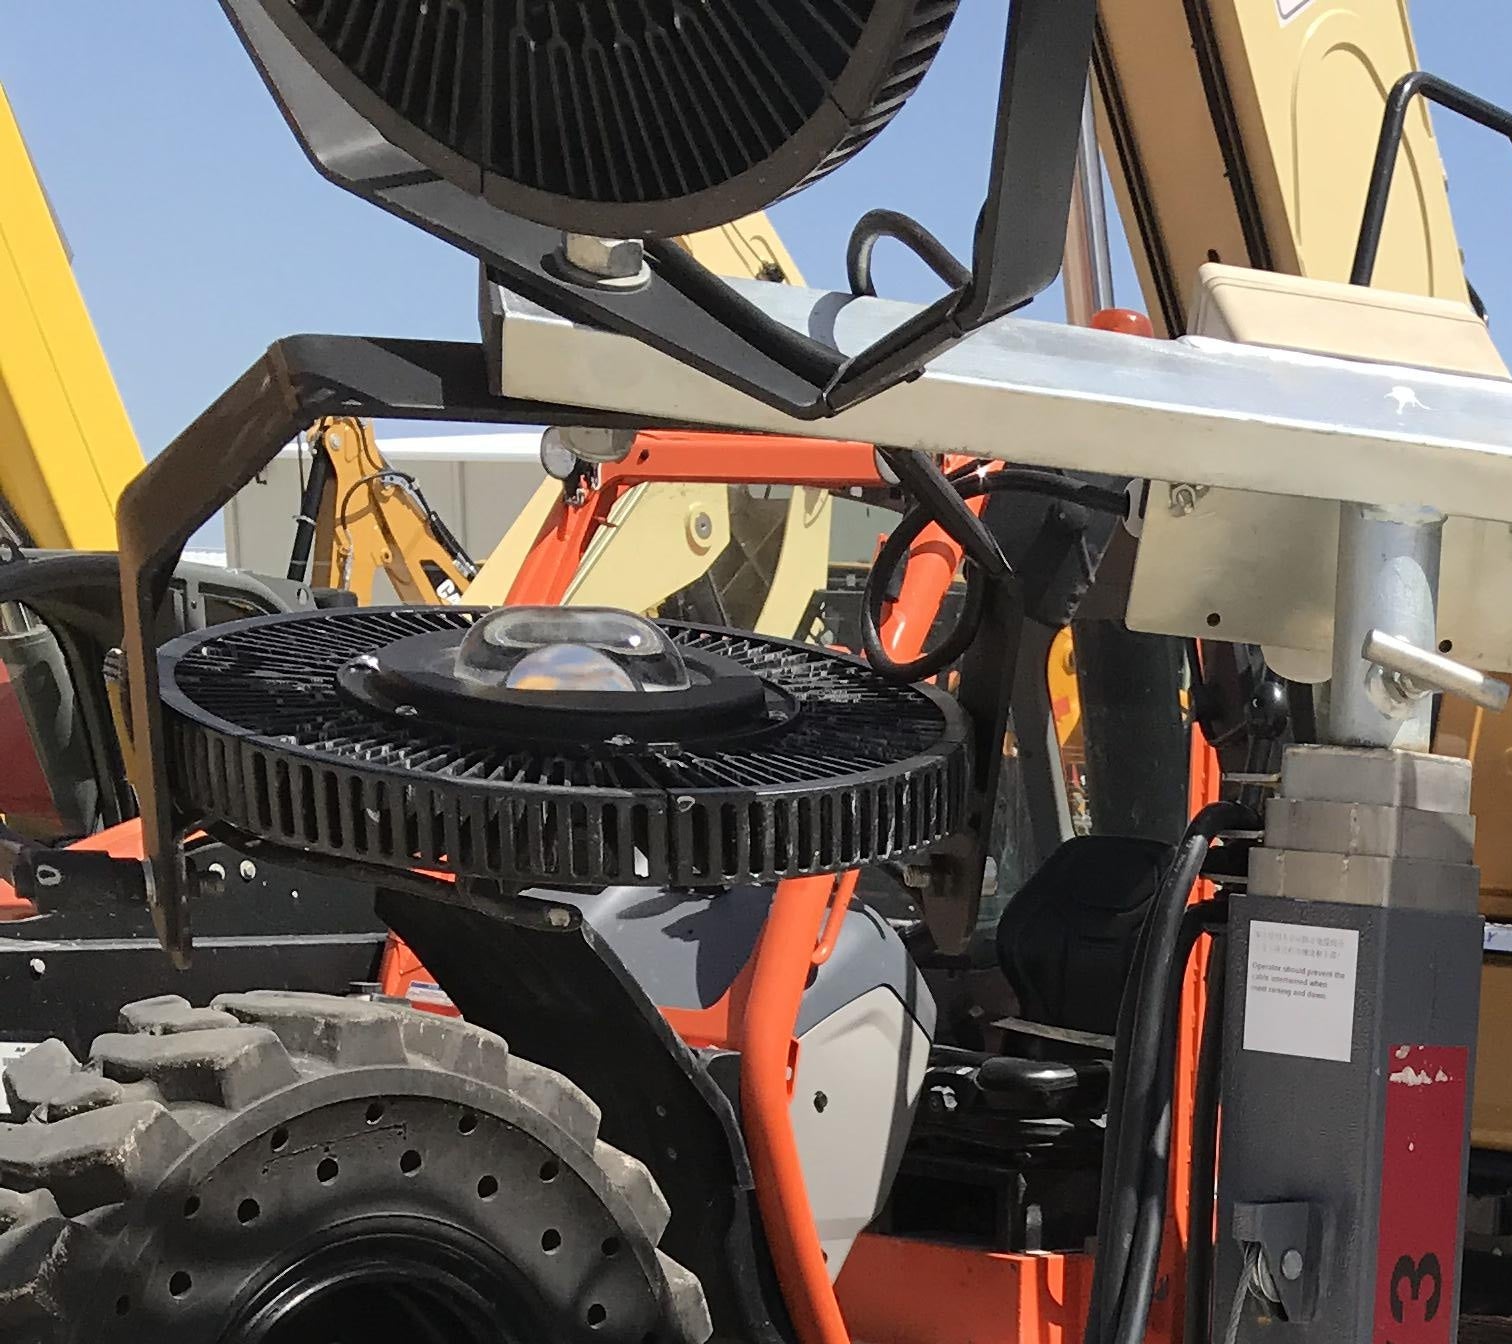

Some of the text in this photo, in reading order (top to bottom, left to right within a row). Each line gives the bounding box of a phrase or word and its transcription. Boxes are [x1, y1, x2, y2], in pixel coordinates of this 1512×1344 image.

[1282, 965, 1306, 975] should
[1334, 971, 1345, 979] the
[1293, 989, 1305, 997] and
